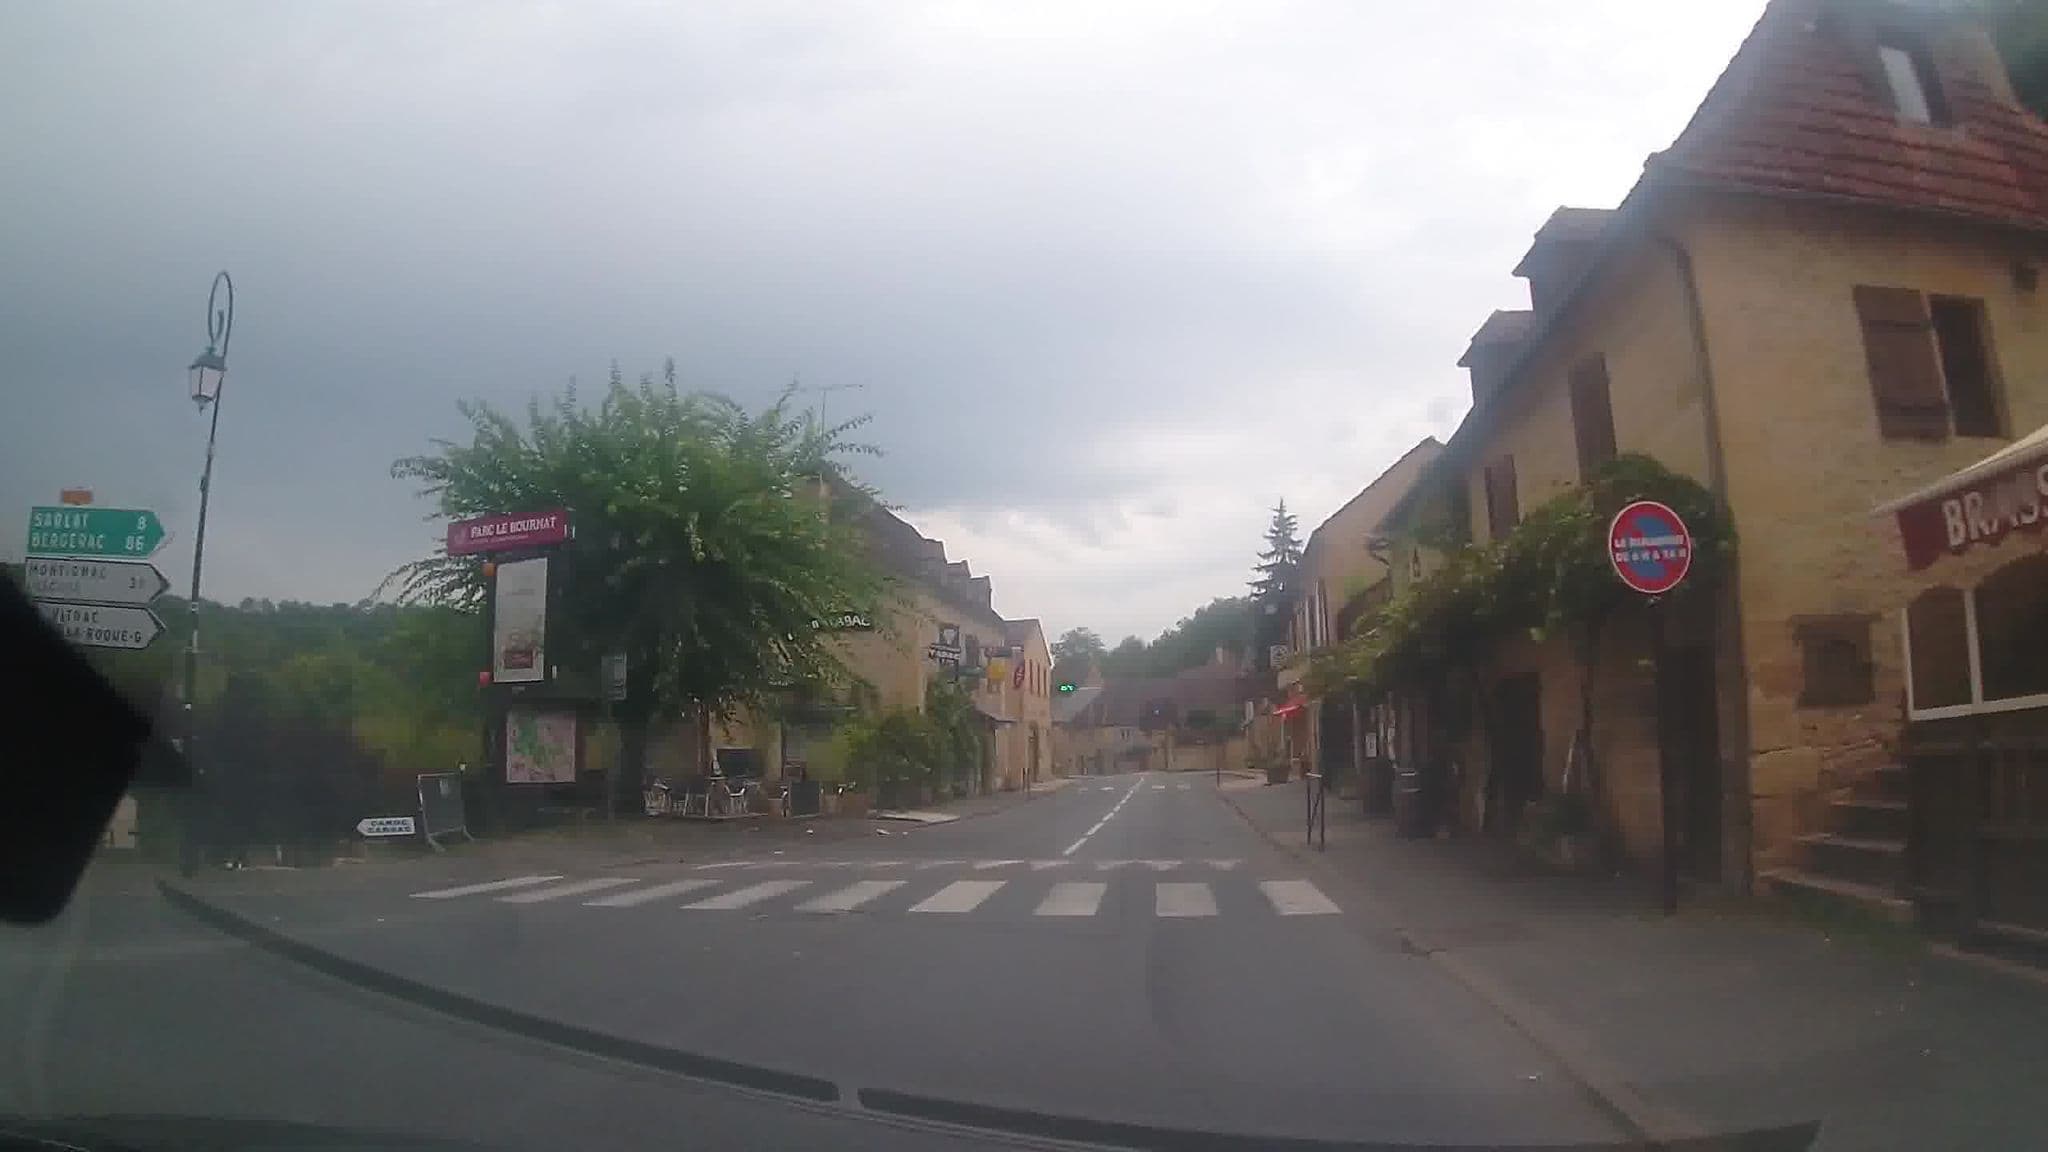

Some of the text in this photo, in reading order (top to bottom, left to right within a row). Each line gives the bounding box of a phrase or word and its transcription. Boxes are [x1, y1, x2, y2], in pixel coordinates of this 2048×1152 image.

[33, 511, 88, 530] SARLAT
[471, 523, 495, 539] PARC
[496, 522, 508, 535] LE
[31, 532, 105, 550] BERGERAC
